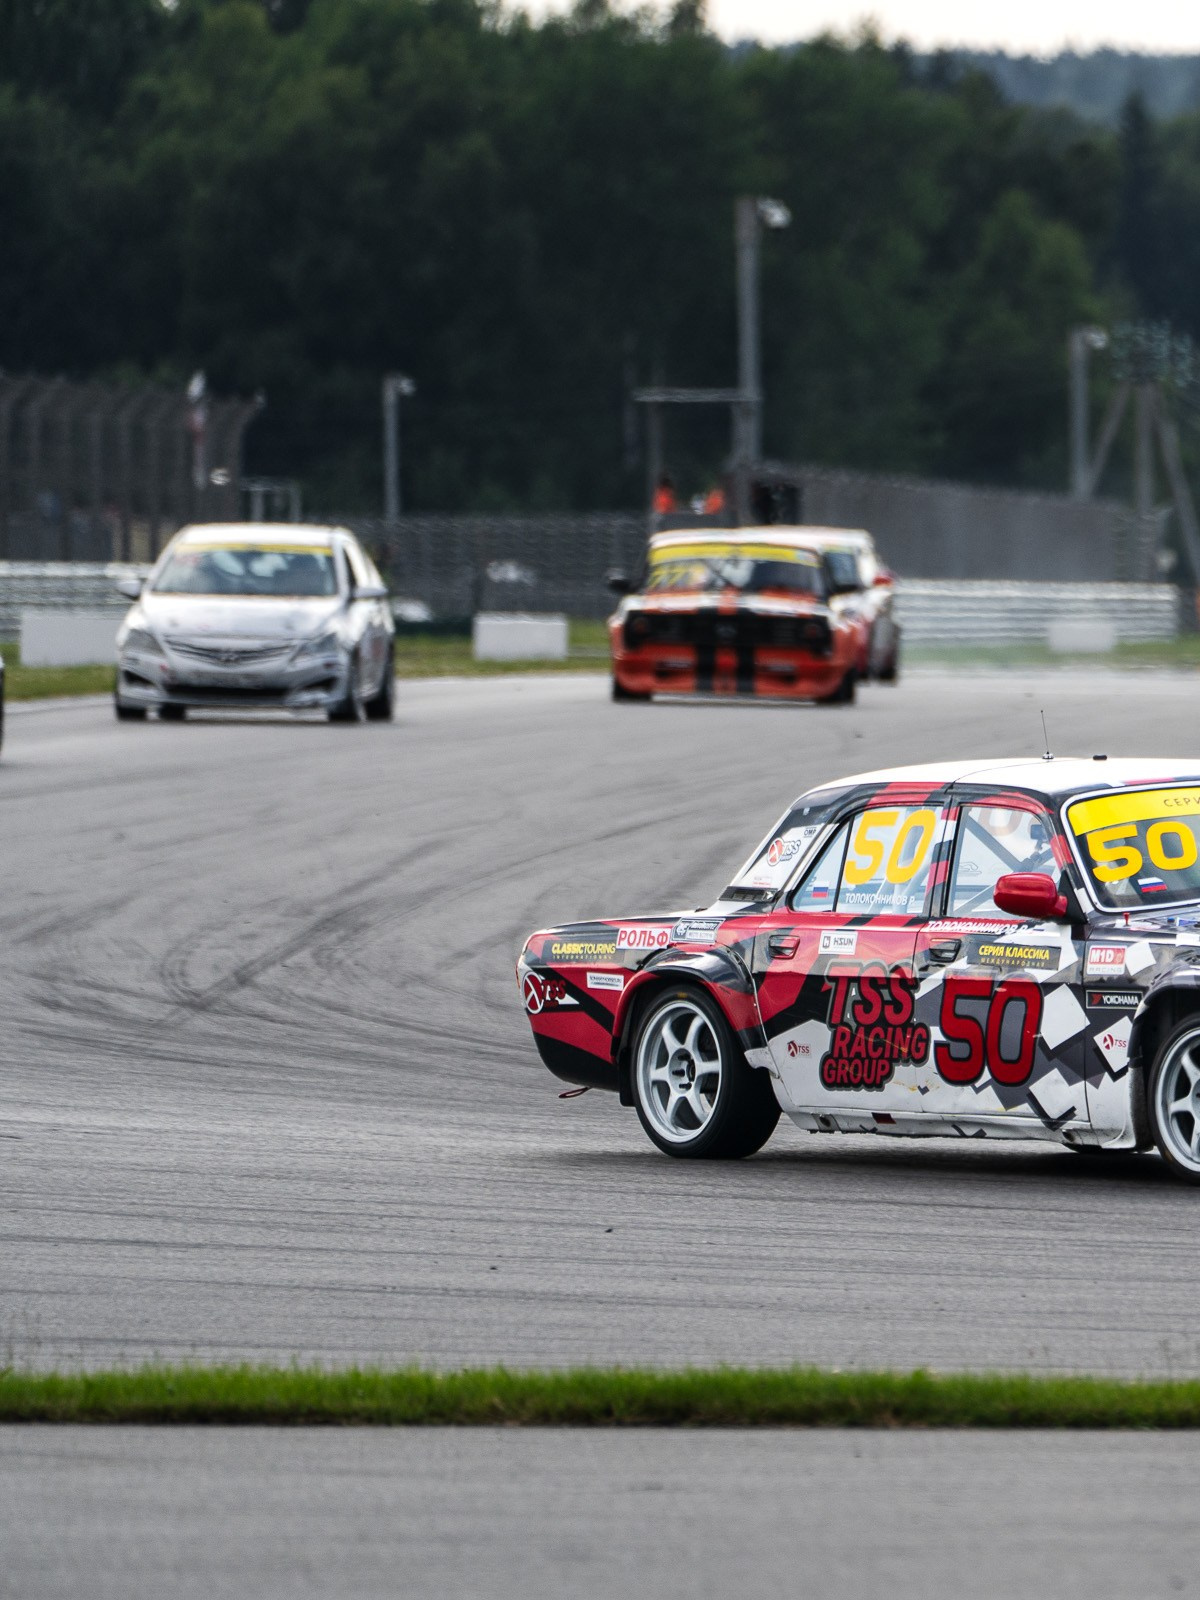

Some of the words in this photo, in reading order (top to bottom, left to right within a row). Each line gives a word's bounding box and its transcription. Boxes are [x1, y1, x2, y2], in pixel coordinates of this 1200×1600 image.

[845, 809, 937, 885] 50
[1086, 821, 1198, 883] 50
[845, 893, 907, 905] ТОЛОКОННИКОВ
[617, 930, 669, 947] РОЛЬФ
[979, 945, 1004, 956] СЕРИЯ
[1006, 947, 1050, 960] КЛАССИКА
[828, 964, 917, 1026] TSS
[1102, 995, 1139, 1005] YOKOHAMA
[934, 972, 1044, 1086] 50
[798, 1045, 810, 1054] TSS
[832, 1025, 927, 1061] RACING
[1114, 1039, 1127, 1048] TSS
[822, 1058, 891, 1085] GROUP
